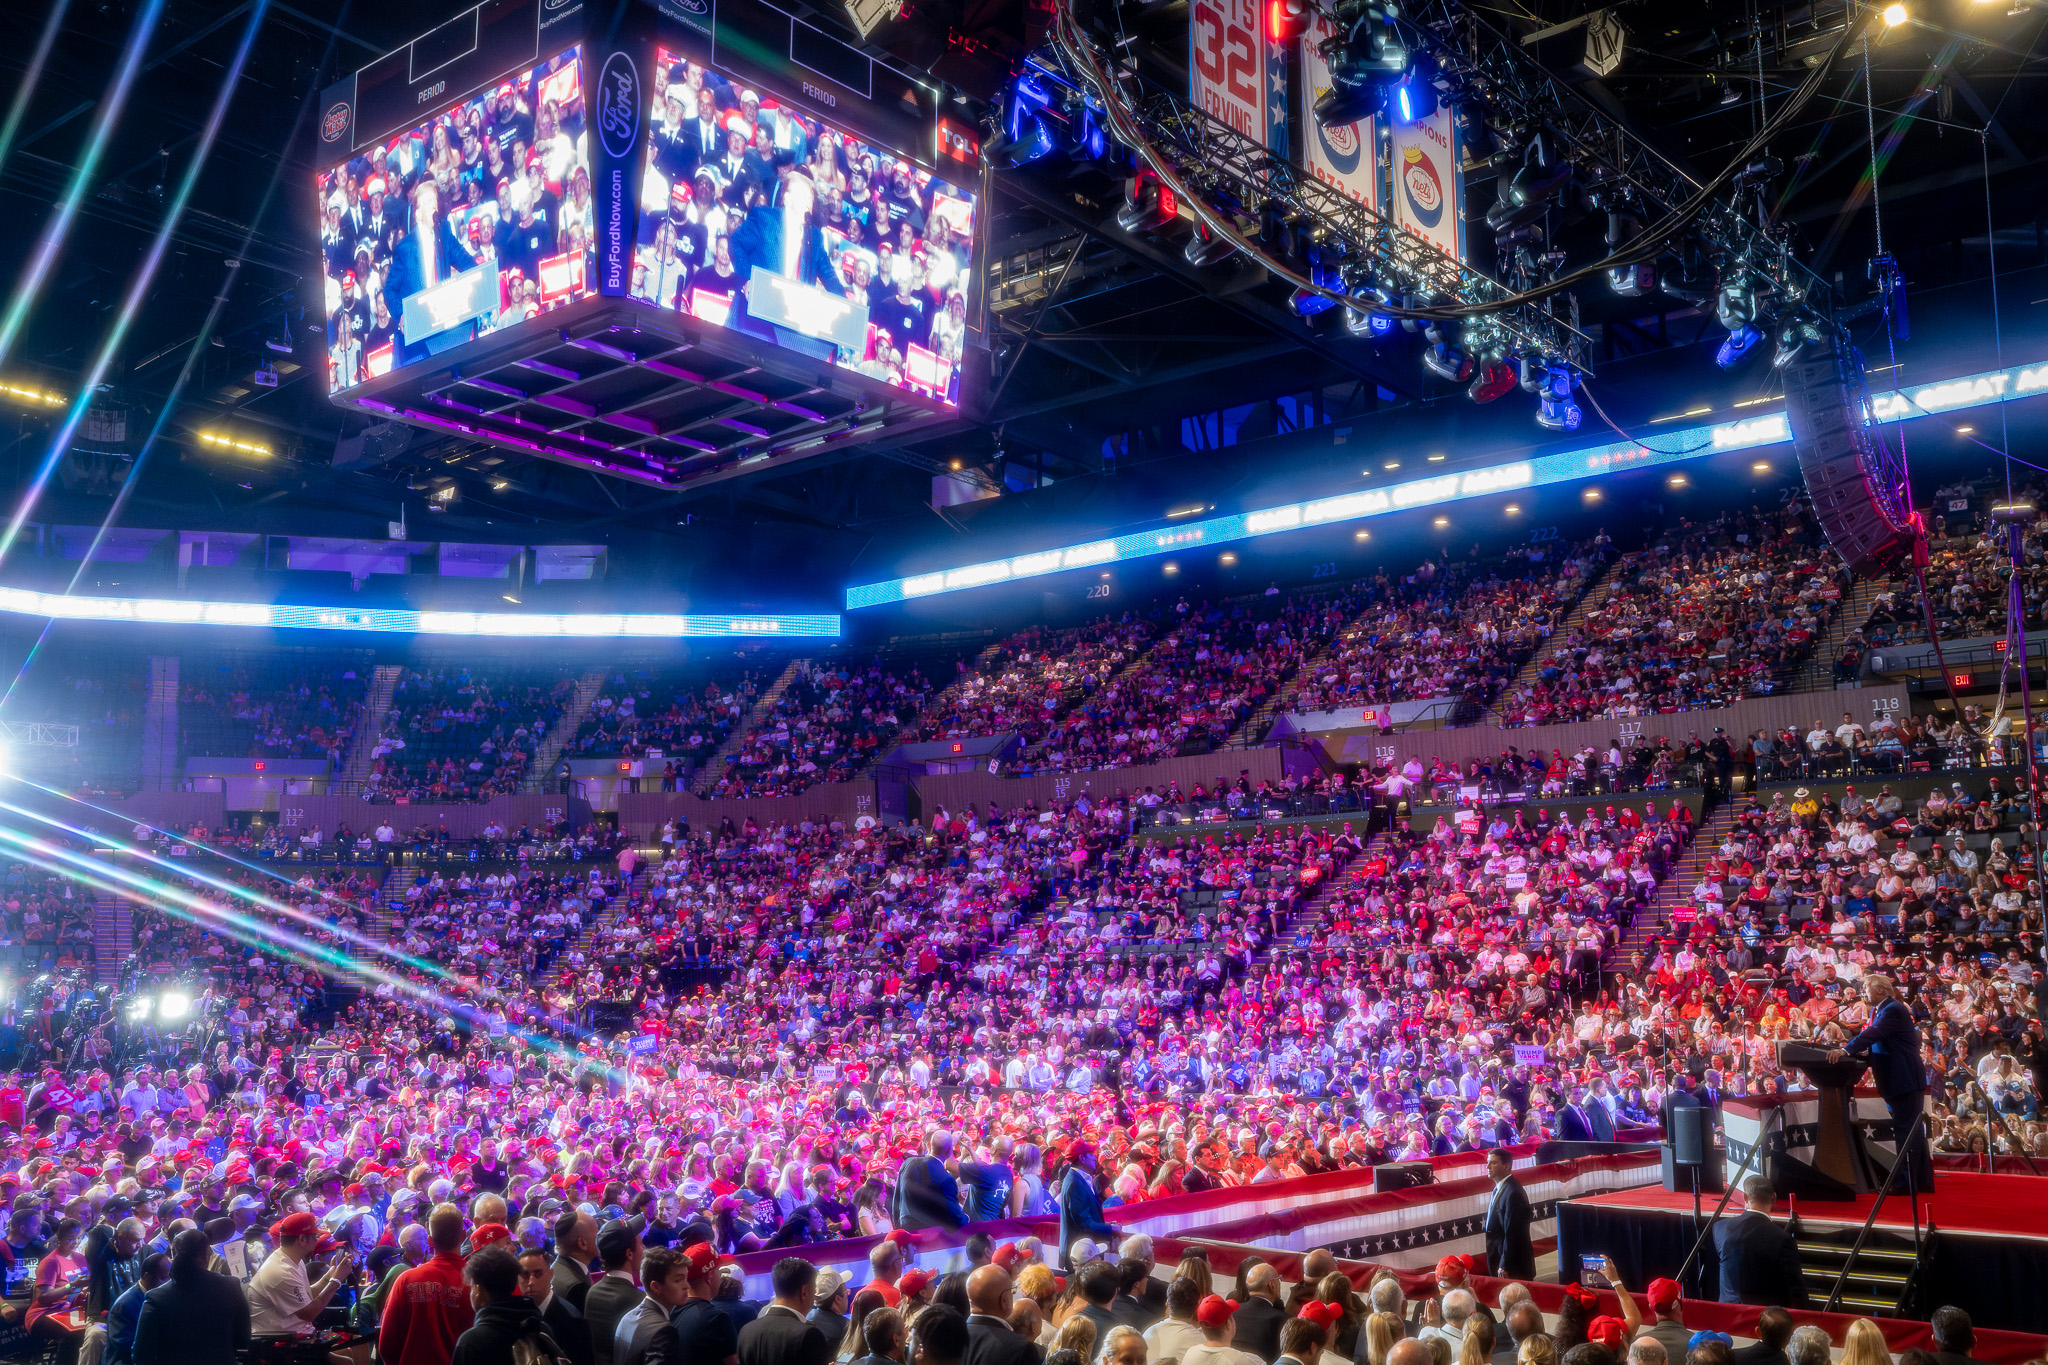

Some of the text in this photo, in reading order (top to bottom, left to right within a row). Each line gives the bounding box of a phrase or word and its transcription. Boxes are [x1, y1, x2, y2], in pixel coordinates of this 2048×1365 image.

[658, 5, 711, 36] BuyFordNow.com
[1195, 2, 1257, 108] 32
[417, 81, 446, 105] PERIOD
[802, 81, 836, 107] PERIOD
[603, 70, 632, 138] Ford
[1204, 86, 1252, 139] ERVING
[941, 127, 973, 154] TCL
[608, 169, 622, 288] BuyFordNow.com
[1951, 500, 1966, 511] 47
[1530, 527, 1559, 543] 222
[1312, 562, 1337, 578] 221
[1086, 584, 1110, 599] 220
[1681, 632, 1695, 641] 47
[1955, 674, 1970, 686] EXIT
[1872, 697, 1900, 711] 118
[1364, 711, 1375, 720] EXIT
[1619, 722, 1642, 734] 117
[1620, 736, 1635, 747] 17
[1375, 745, 1395, 757] 116
[1055, 777, 1071, 787] 115
[856, 794, 872, 804] 114
[1056, 788, 1066, 799] 15
[285, 808, 305, 817] 112
[545, 807, 562, 816] 113
[285, 818, 298, 827] 12
[172, 846, 185, 854] 47
[533, 929, 546, 938] 47
[632, 1037, 655, 1047] TRUMP
[634, 1042, 653, 1050] VANCE
[48, 1088, 75, 1107] 47
[14, 1257, 39, 1267] RUMP
[701, 1259, 716, 1274] 45-47
